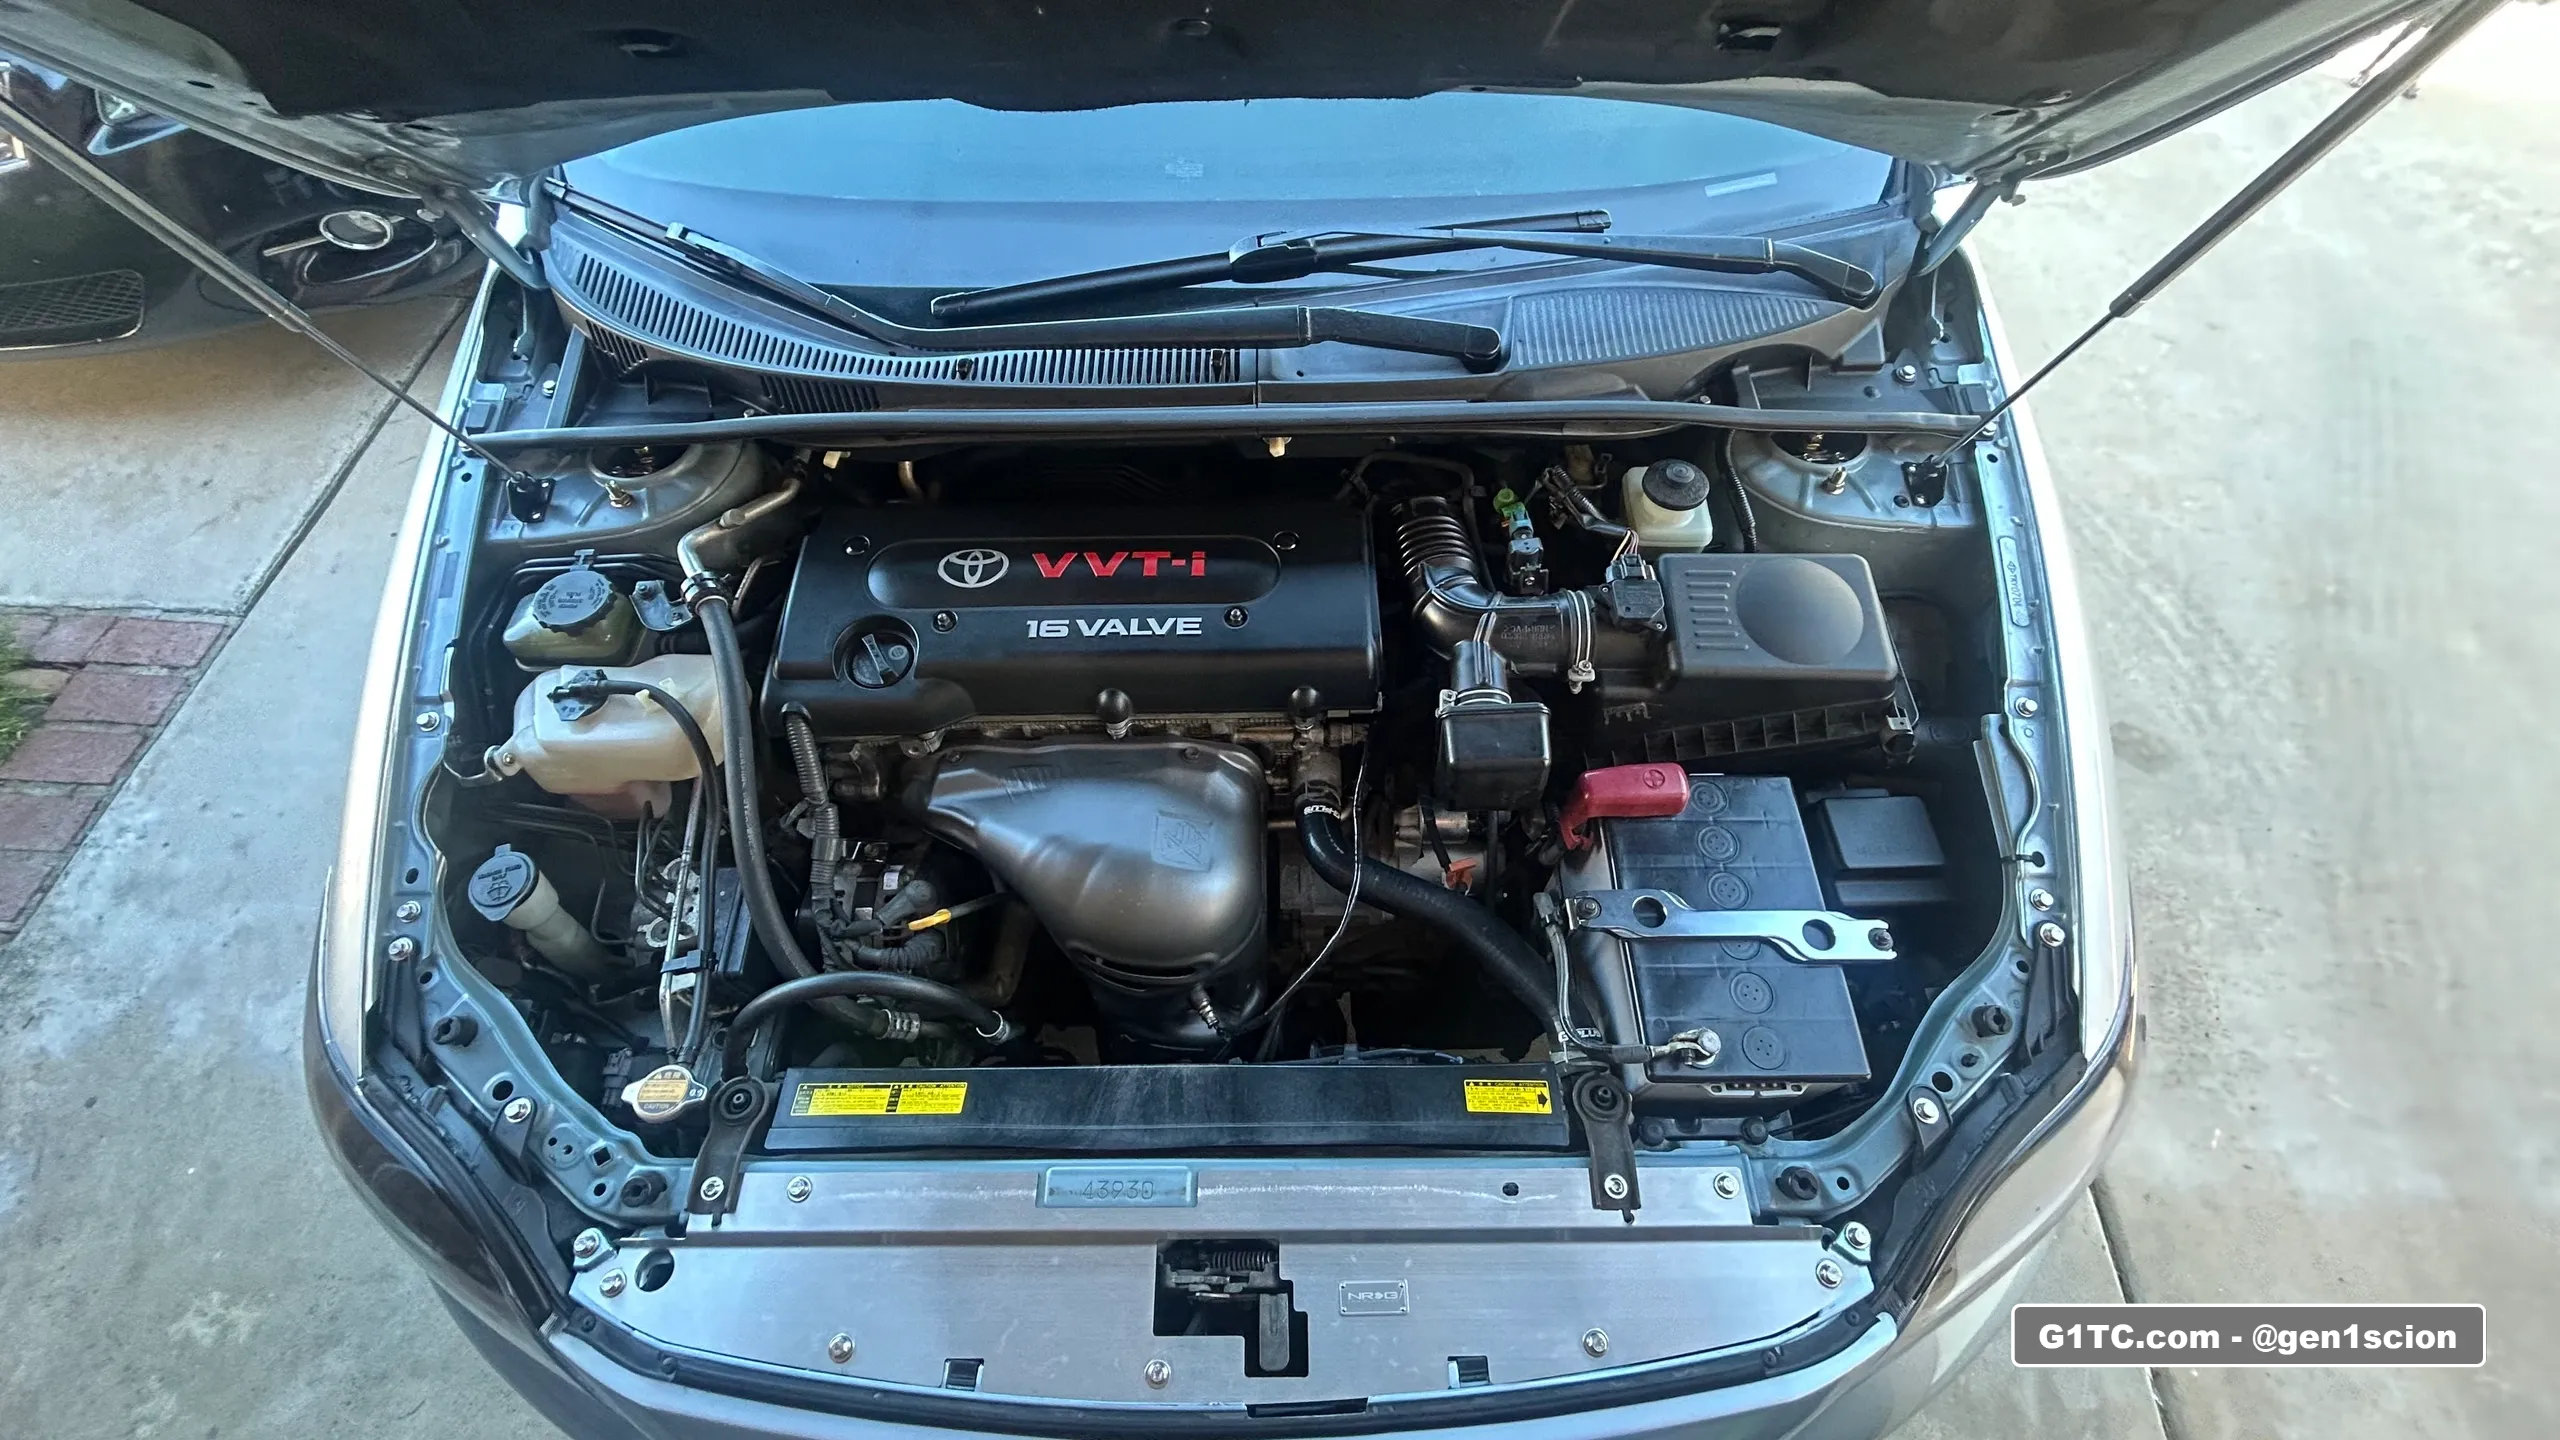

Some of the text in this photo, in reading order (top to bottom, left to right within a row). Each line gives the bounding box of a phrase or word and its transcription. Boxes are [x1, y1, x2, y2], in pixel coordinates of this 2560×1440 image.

[1032, 551, 1206, 578] VVT-i
[1026, 617, 1203, 639] 16 VALVE
[688, 1088, 703, 1097] 0.9
[1081, 1180, 1155, 1200] 43930
